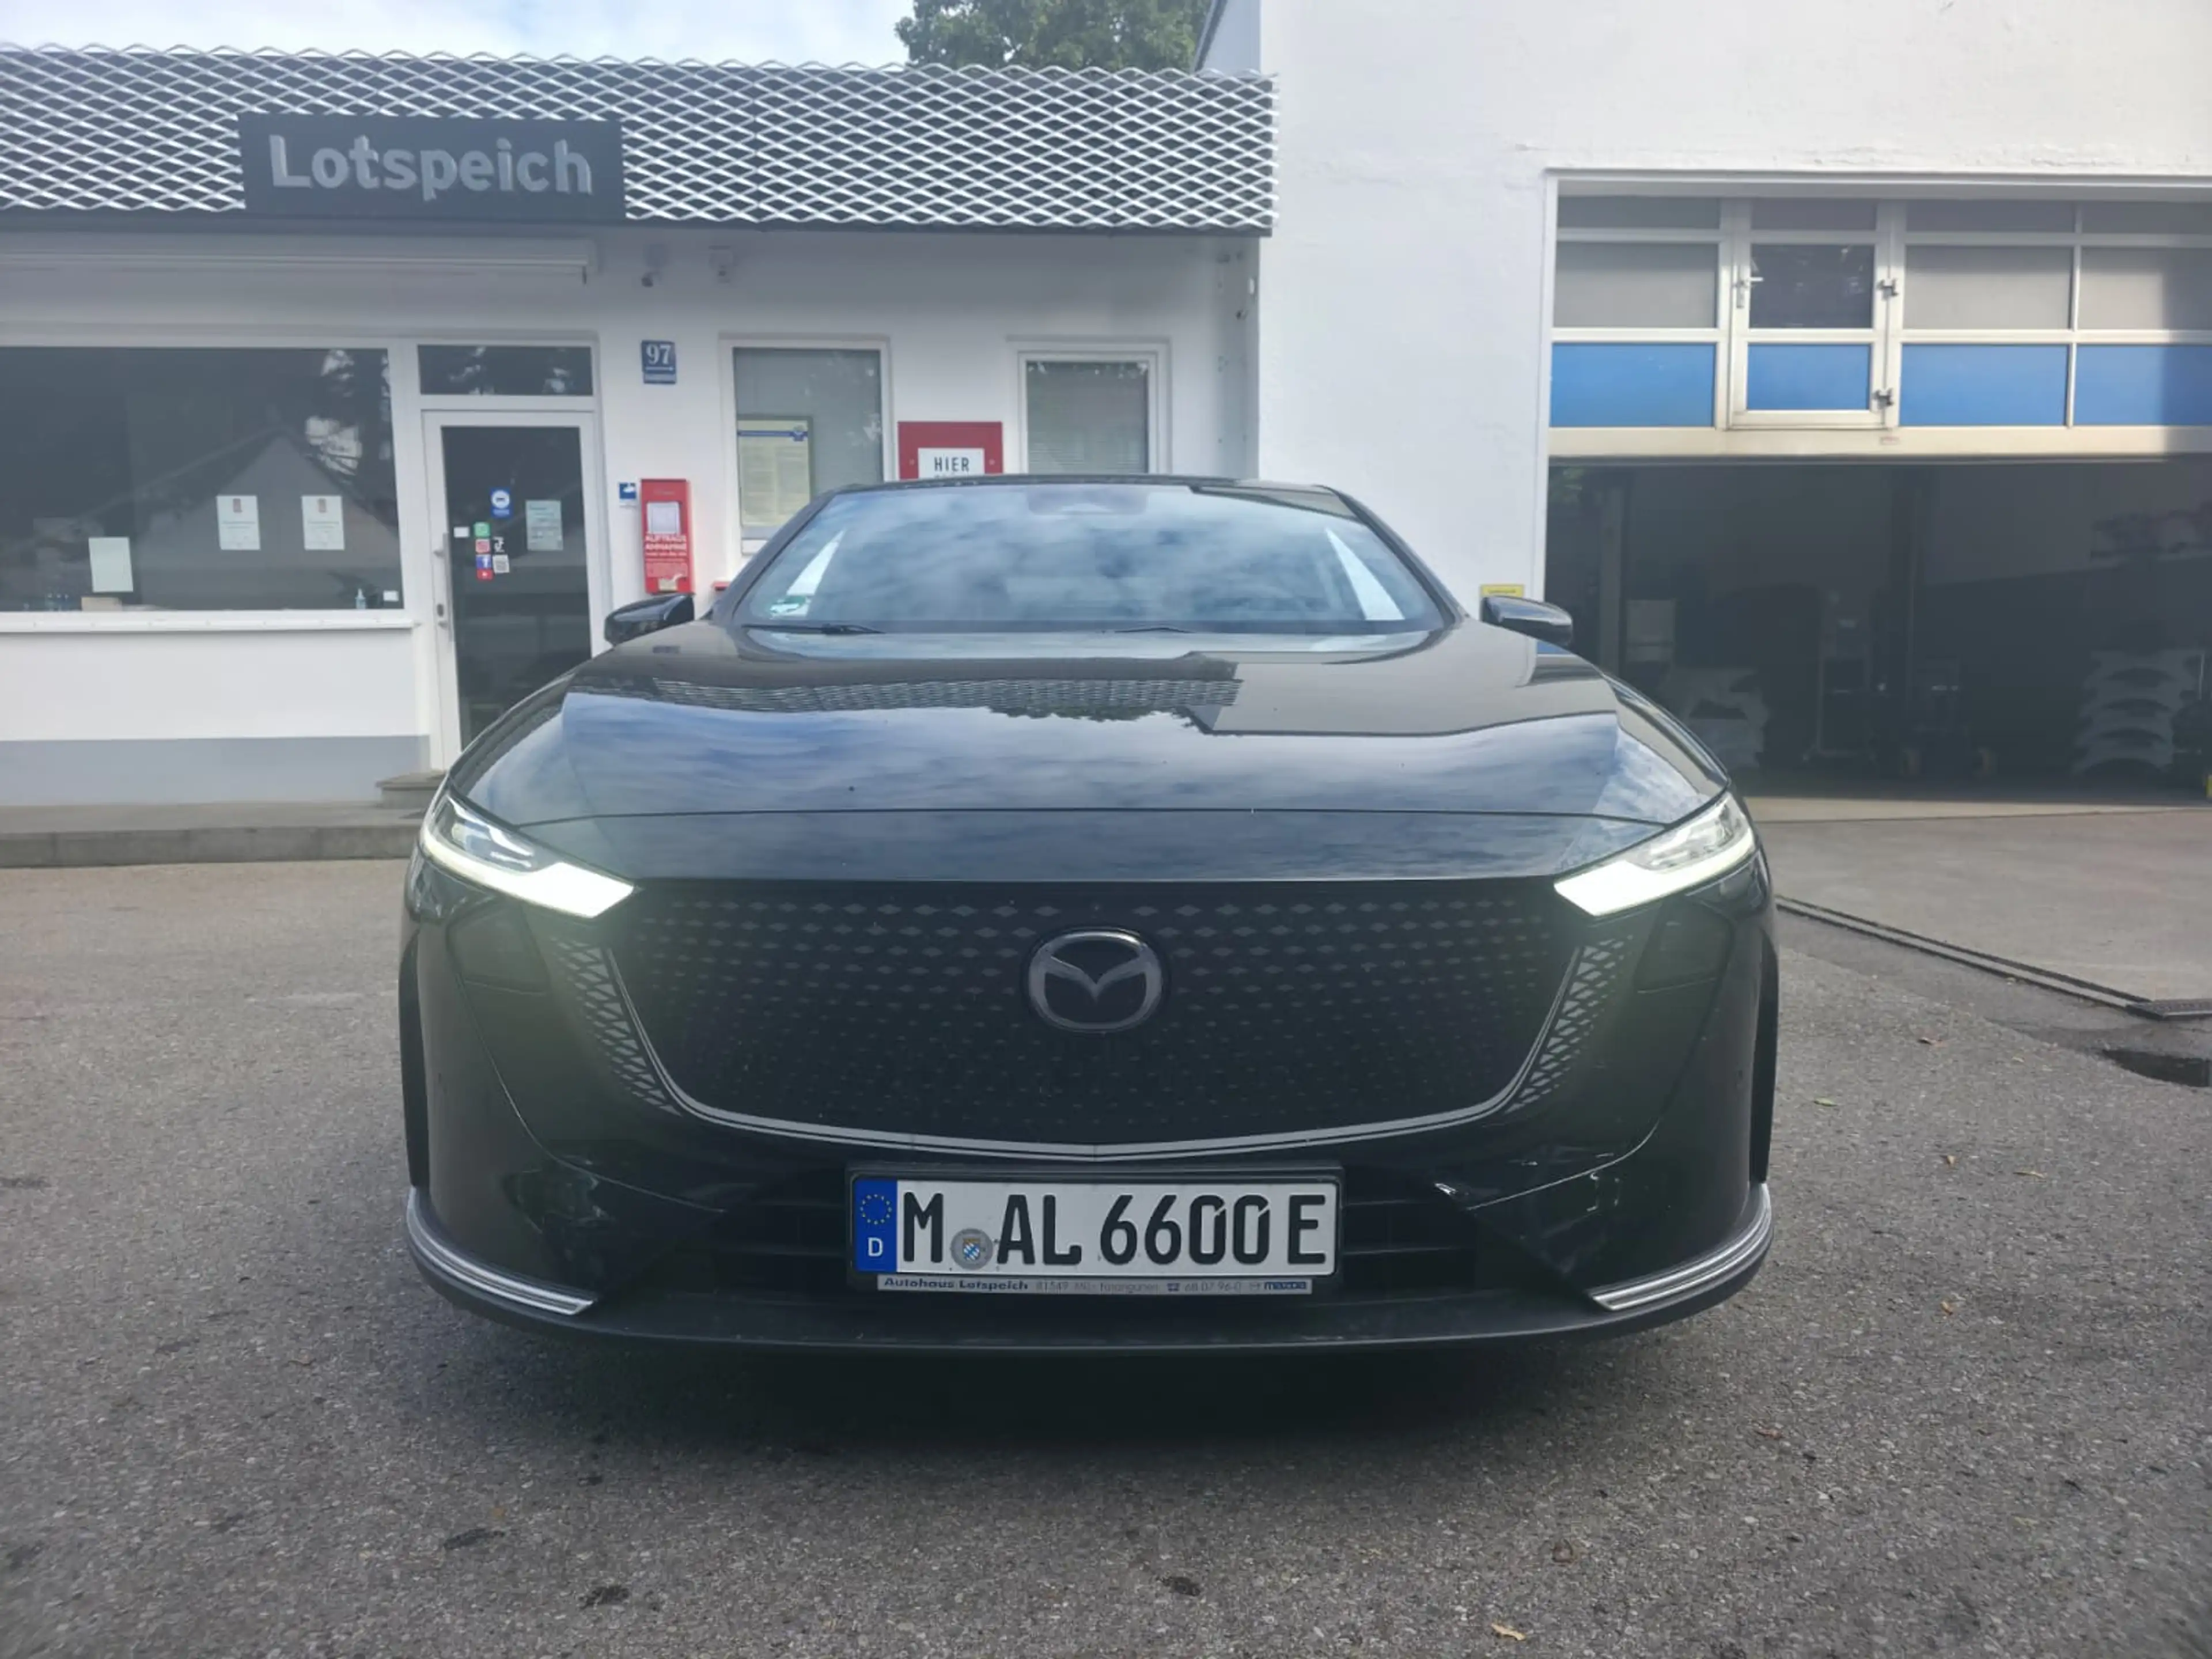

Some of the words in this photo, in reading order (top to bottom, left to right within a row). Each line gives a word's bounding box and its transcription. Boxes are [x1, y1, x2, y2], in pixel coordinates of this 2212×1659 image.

[268, 134, 593, 202] Lotspeich
[646, 344, 671, 365] 97
[934, 457, 970, 472] HIER
[903, 1191, 944, 1263] M
[997, 1194, 1082, 1265] AL
[867, 1237, 883, 1257] D
[884, 1277, 954, 1289] Autohaus
[959, 1279, 1028, 1291] Lotspeich
